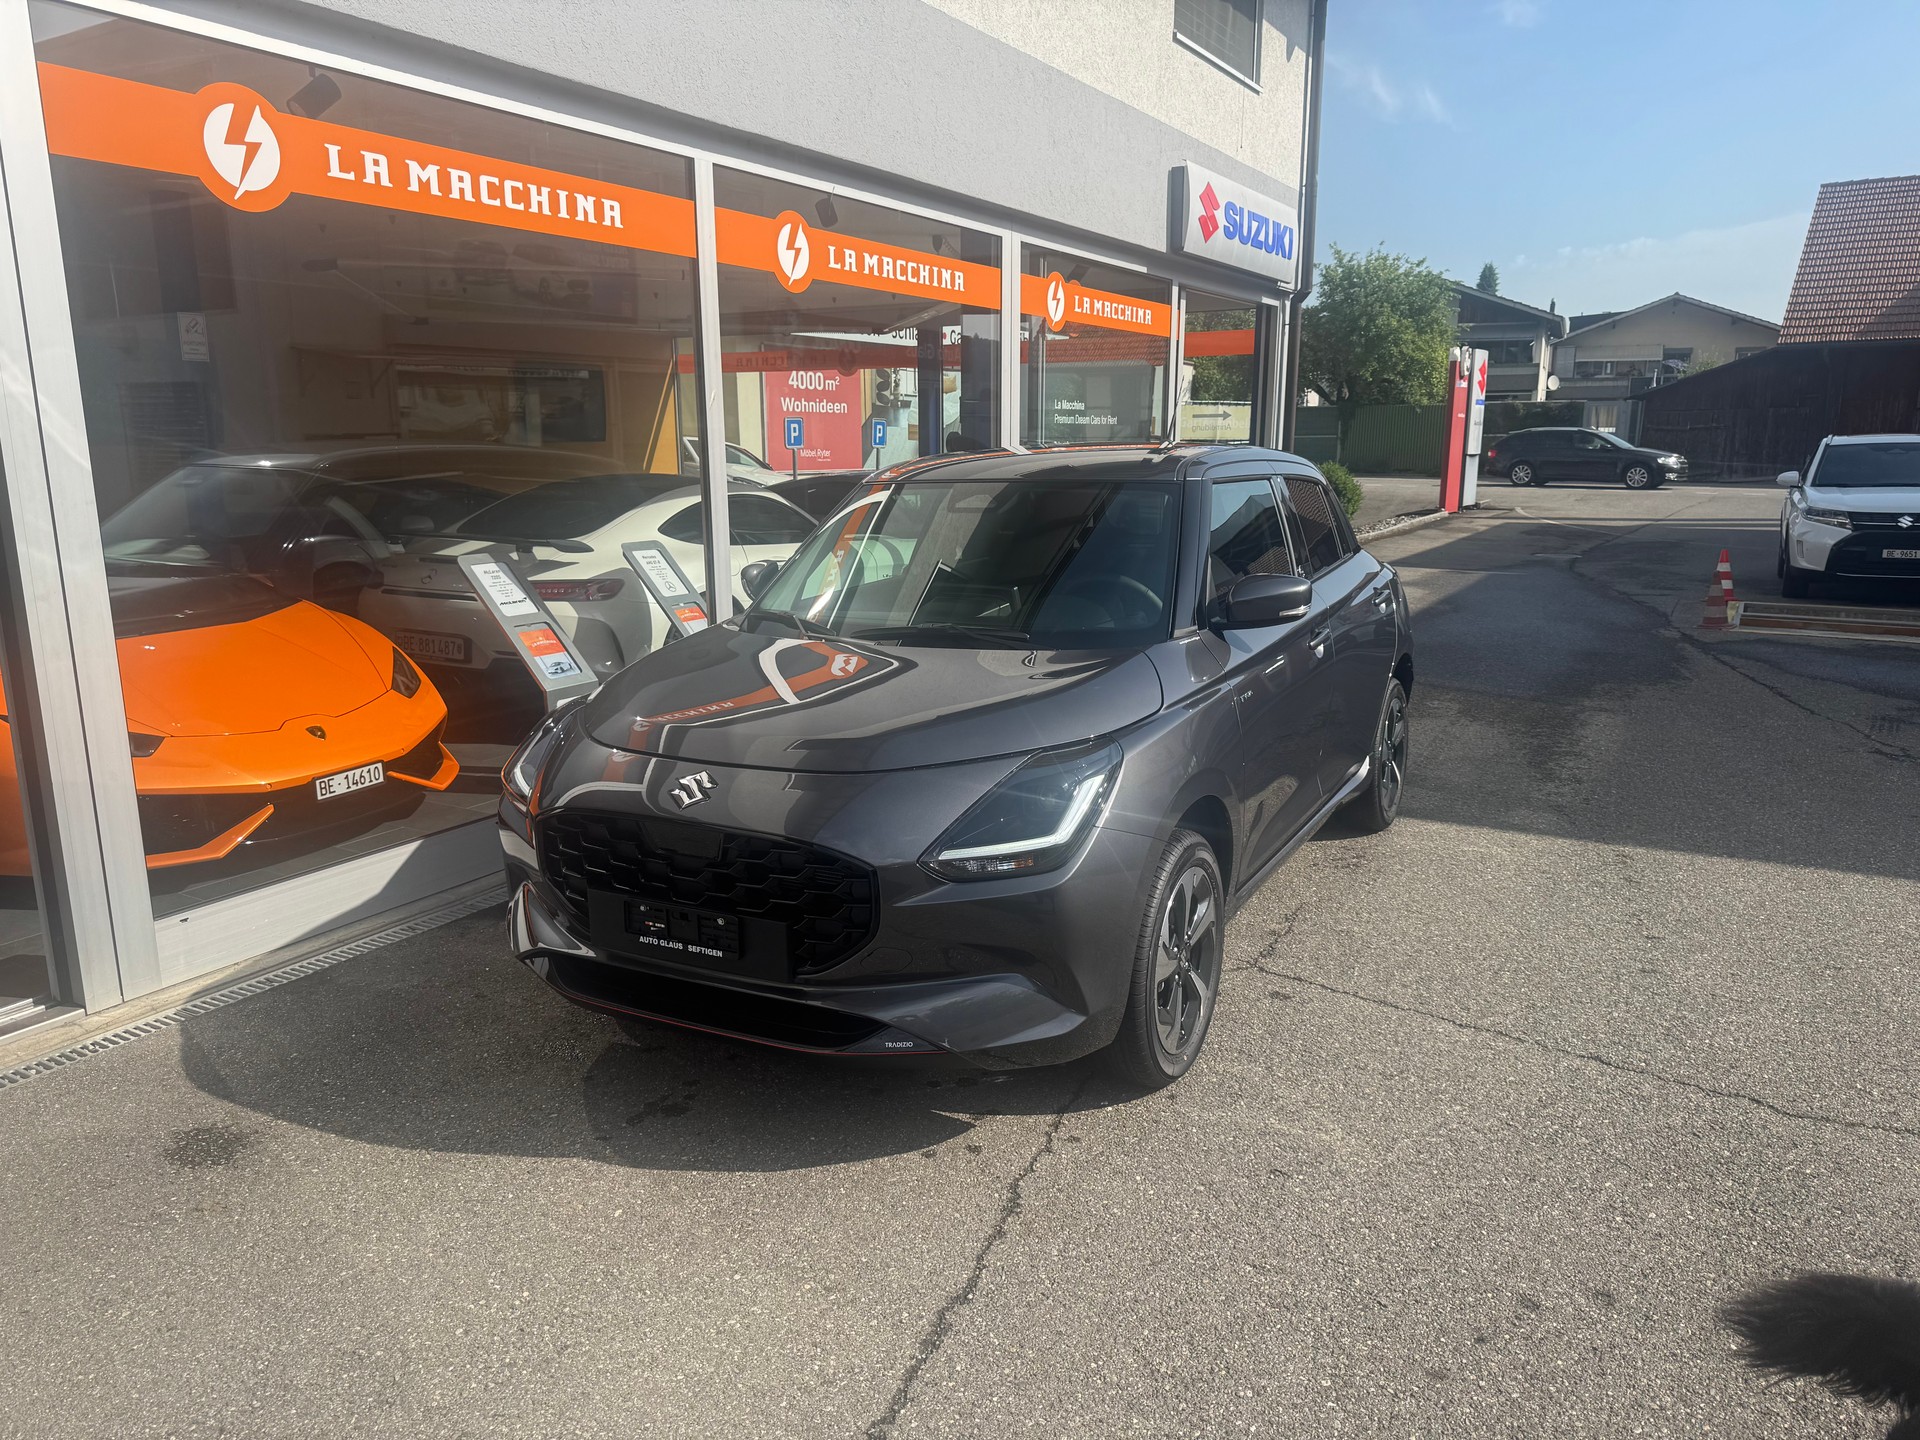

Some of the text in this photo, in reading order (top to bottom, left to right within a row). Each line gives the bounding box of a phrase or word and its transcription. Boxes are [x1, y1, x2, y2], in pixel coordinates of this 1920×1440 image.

[324, 143, 624, 229] LA MACCHINA
[1223, 200, 1294, 260] SUZUKI
[828, 245, 965, 291] LA MACCHINA
[1074, 295, 1152, 325] LA MACCHINA
[781, 397, 848, 414] Wohnideen
[1054, 399, 1085, 411] La Macchina
[1054, 414, 1074, 424] Premium
[1075, 414, 1090, 425] Dream
[1091, 415, 1101, 425] Cars
[1107, 416, 1118, 425] Rent
[790, 423, 799, 444] P
[876, 425, 883, 443] P
[800, 449, 831, 458] Möbel Ryter
[639, 936, 723, 957] AUTO GLAUS SEFTIGEN
